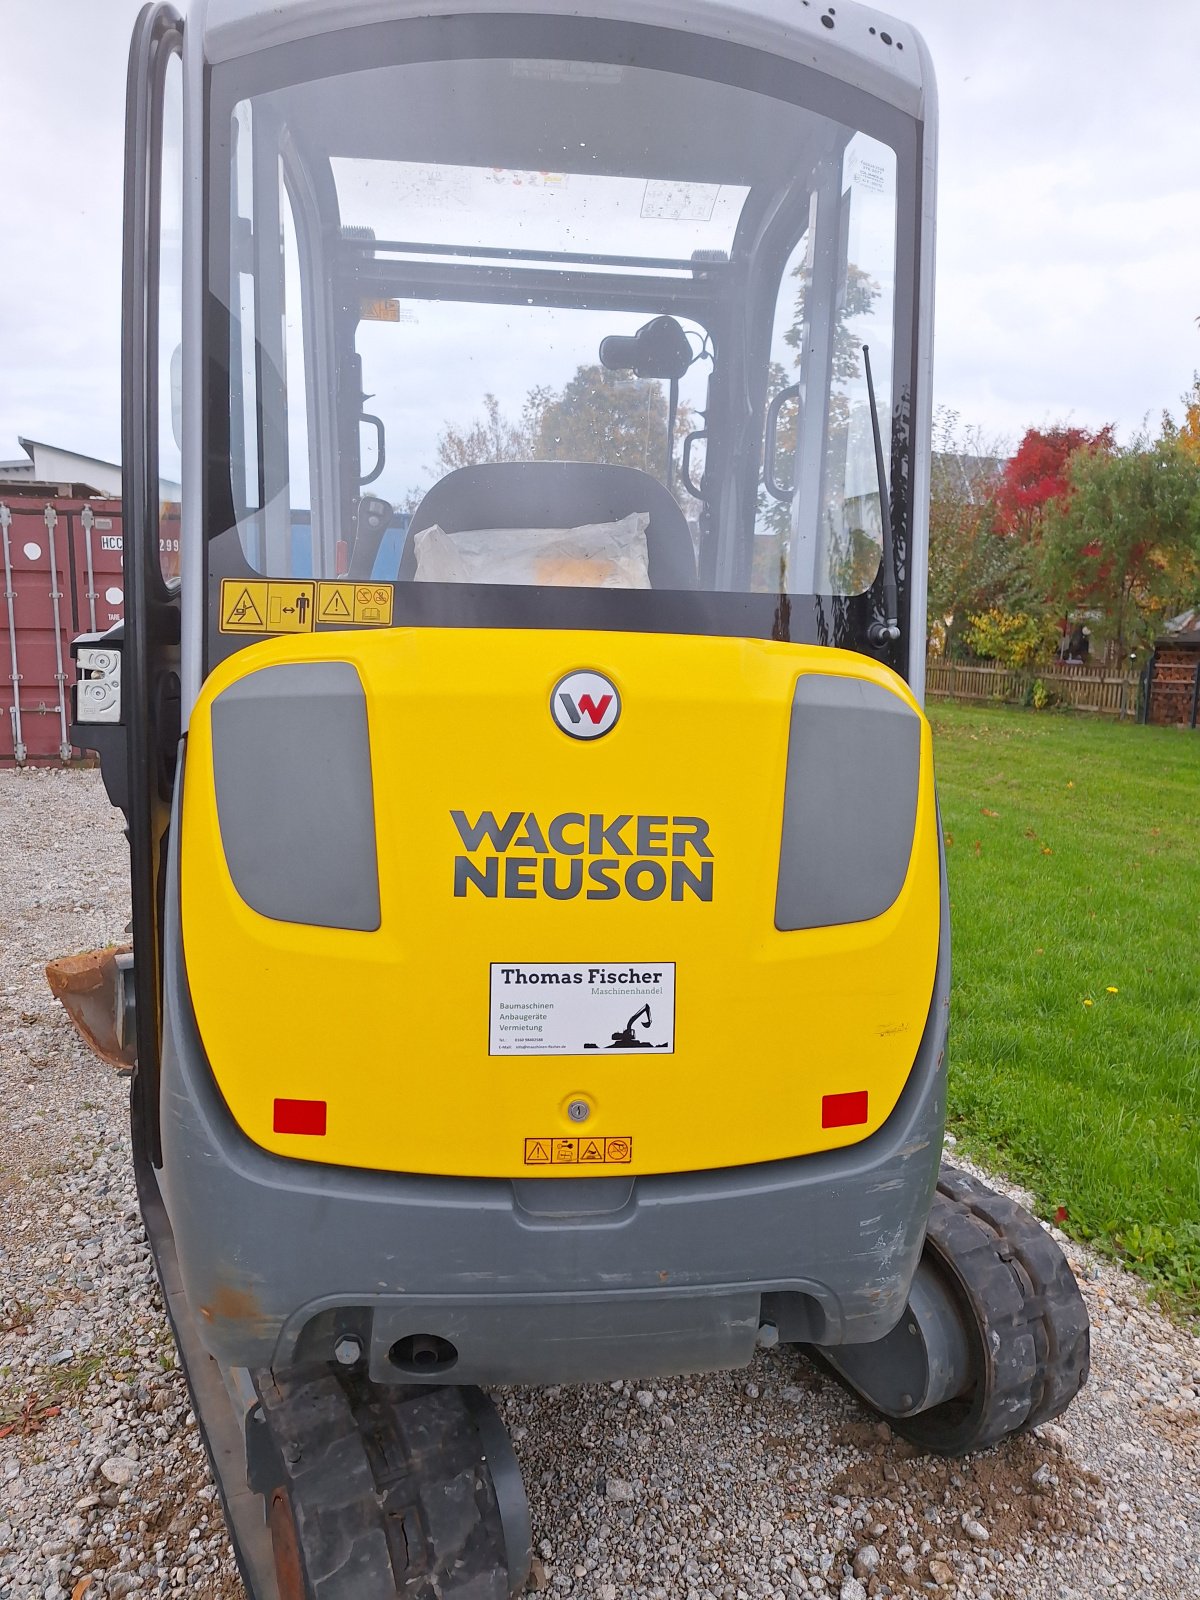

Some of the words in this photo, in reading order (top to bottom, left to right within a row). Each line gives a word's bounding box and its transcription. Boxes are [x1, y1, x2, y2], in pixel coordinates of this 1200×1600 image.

[449, 810, 714, 857] WACKER
[454, 856, 714, 902] NEUSON
[501, 968, 583, 984] Thomas
[588, 968, 663, 984] Fischer
[591, 987, 663, 995] Maschinenhandel
[499, 1002, 554, 1010] Baumaschinen
[499, 1013, 548, 1022] Anbaugeräte
[499, 1024, 543, 1033] Vermietung
